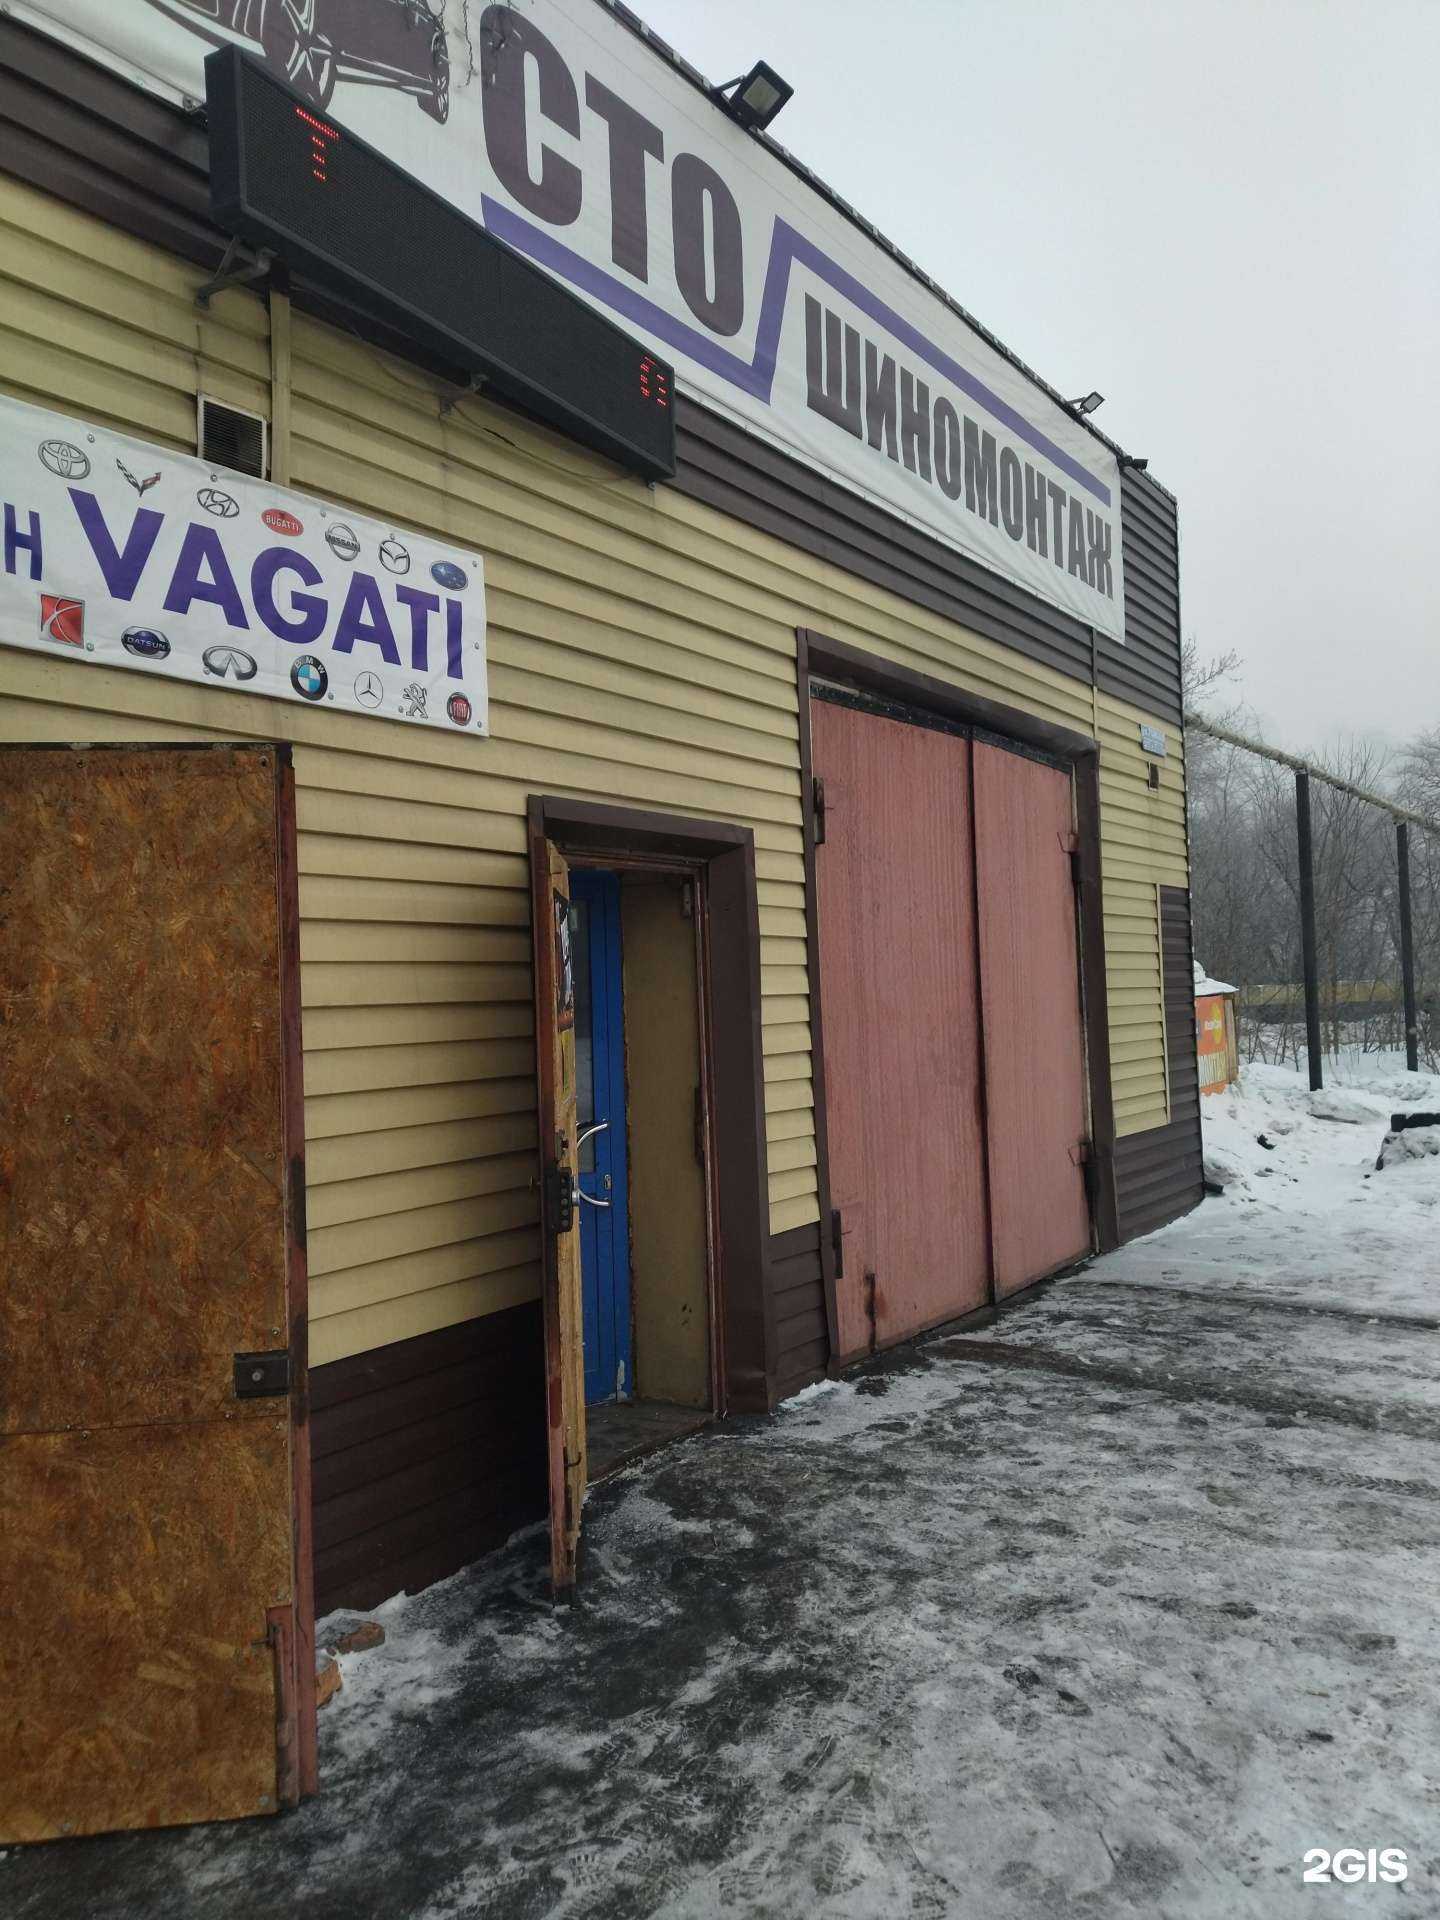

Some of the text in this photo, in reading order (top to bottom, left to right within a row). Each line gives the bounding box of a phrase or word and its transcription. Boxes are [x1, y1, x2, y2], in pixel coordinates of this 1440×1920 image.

[480, 4, 744, 337] СТО
[265, 514, 300, 533] BUGATTI
[805, 292, 1113, 600] ШИНОМОНТАЖ
[67, 487, 464, 680] VAGATI
[127, 636, 166, 650] DATSUN
